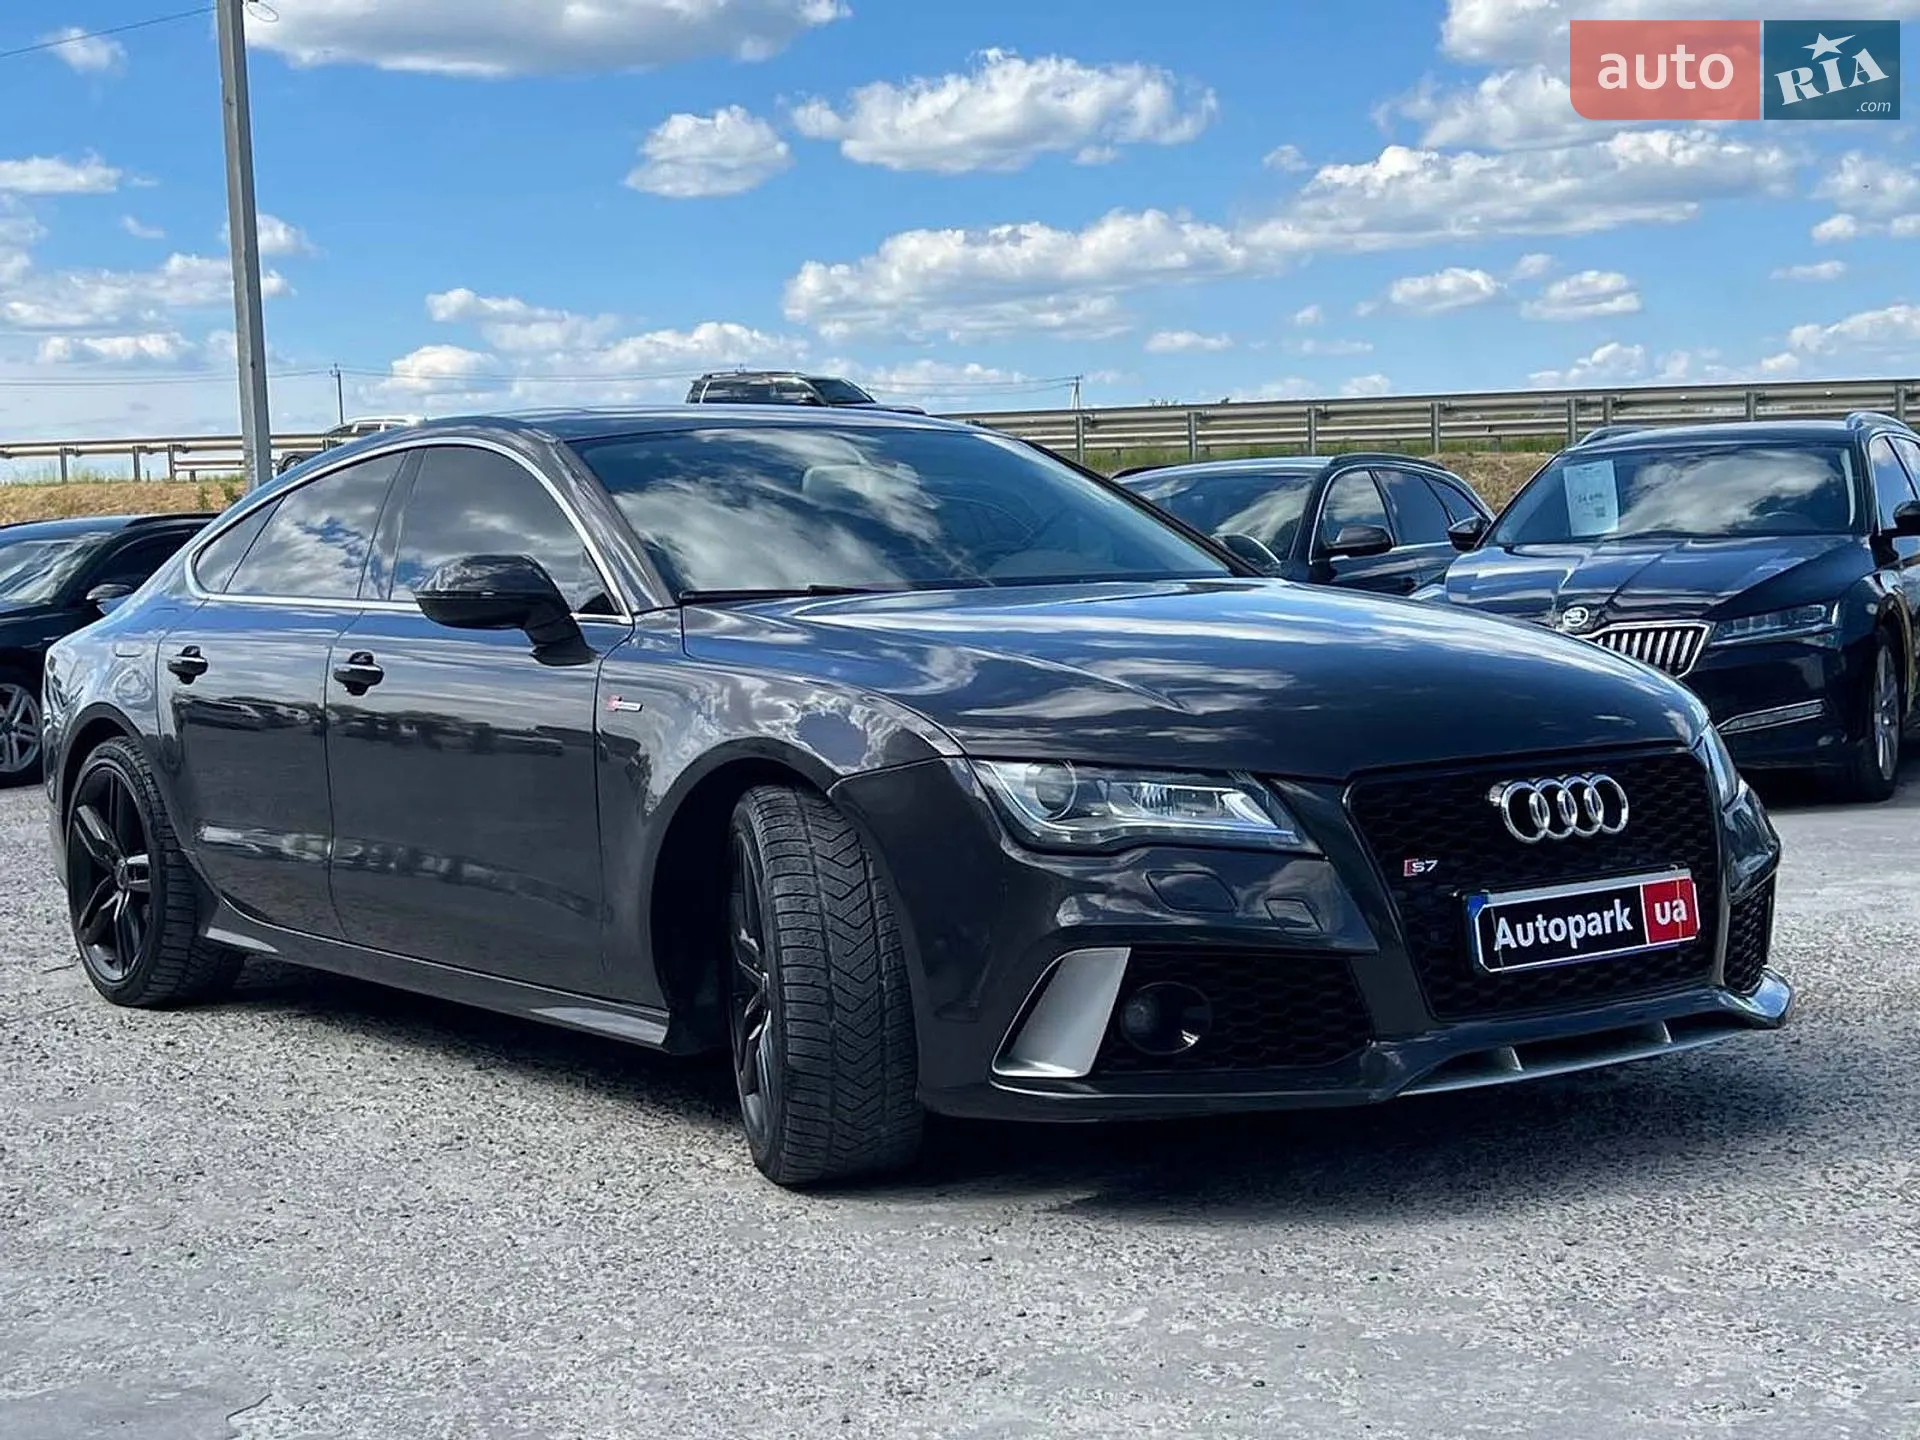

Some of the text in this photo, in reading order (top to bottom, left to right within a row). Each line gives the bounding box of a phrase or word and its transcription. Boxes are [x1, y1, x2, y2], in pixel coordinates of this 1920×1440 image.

[1410, 859, 1439, 873] S7
[1494, 898, 1688, 951] Autopark ua
